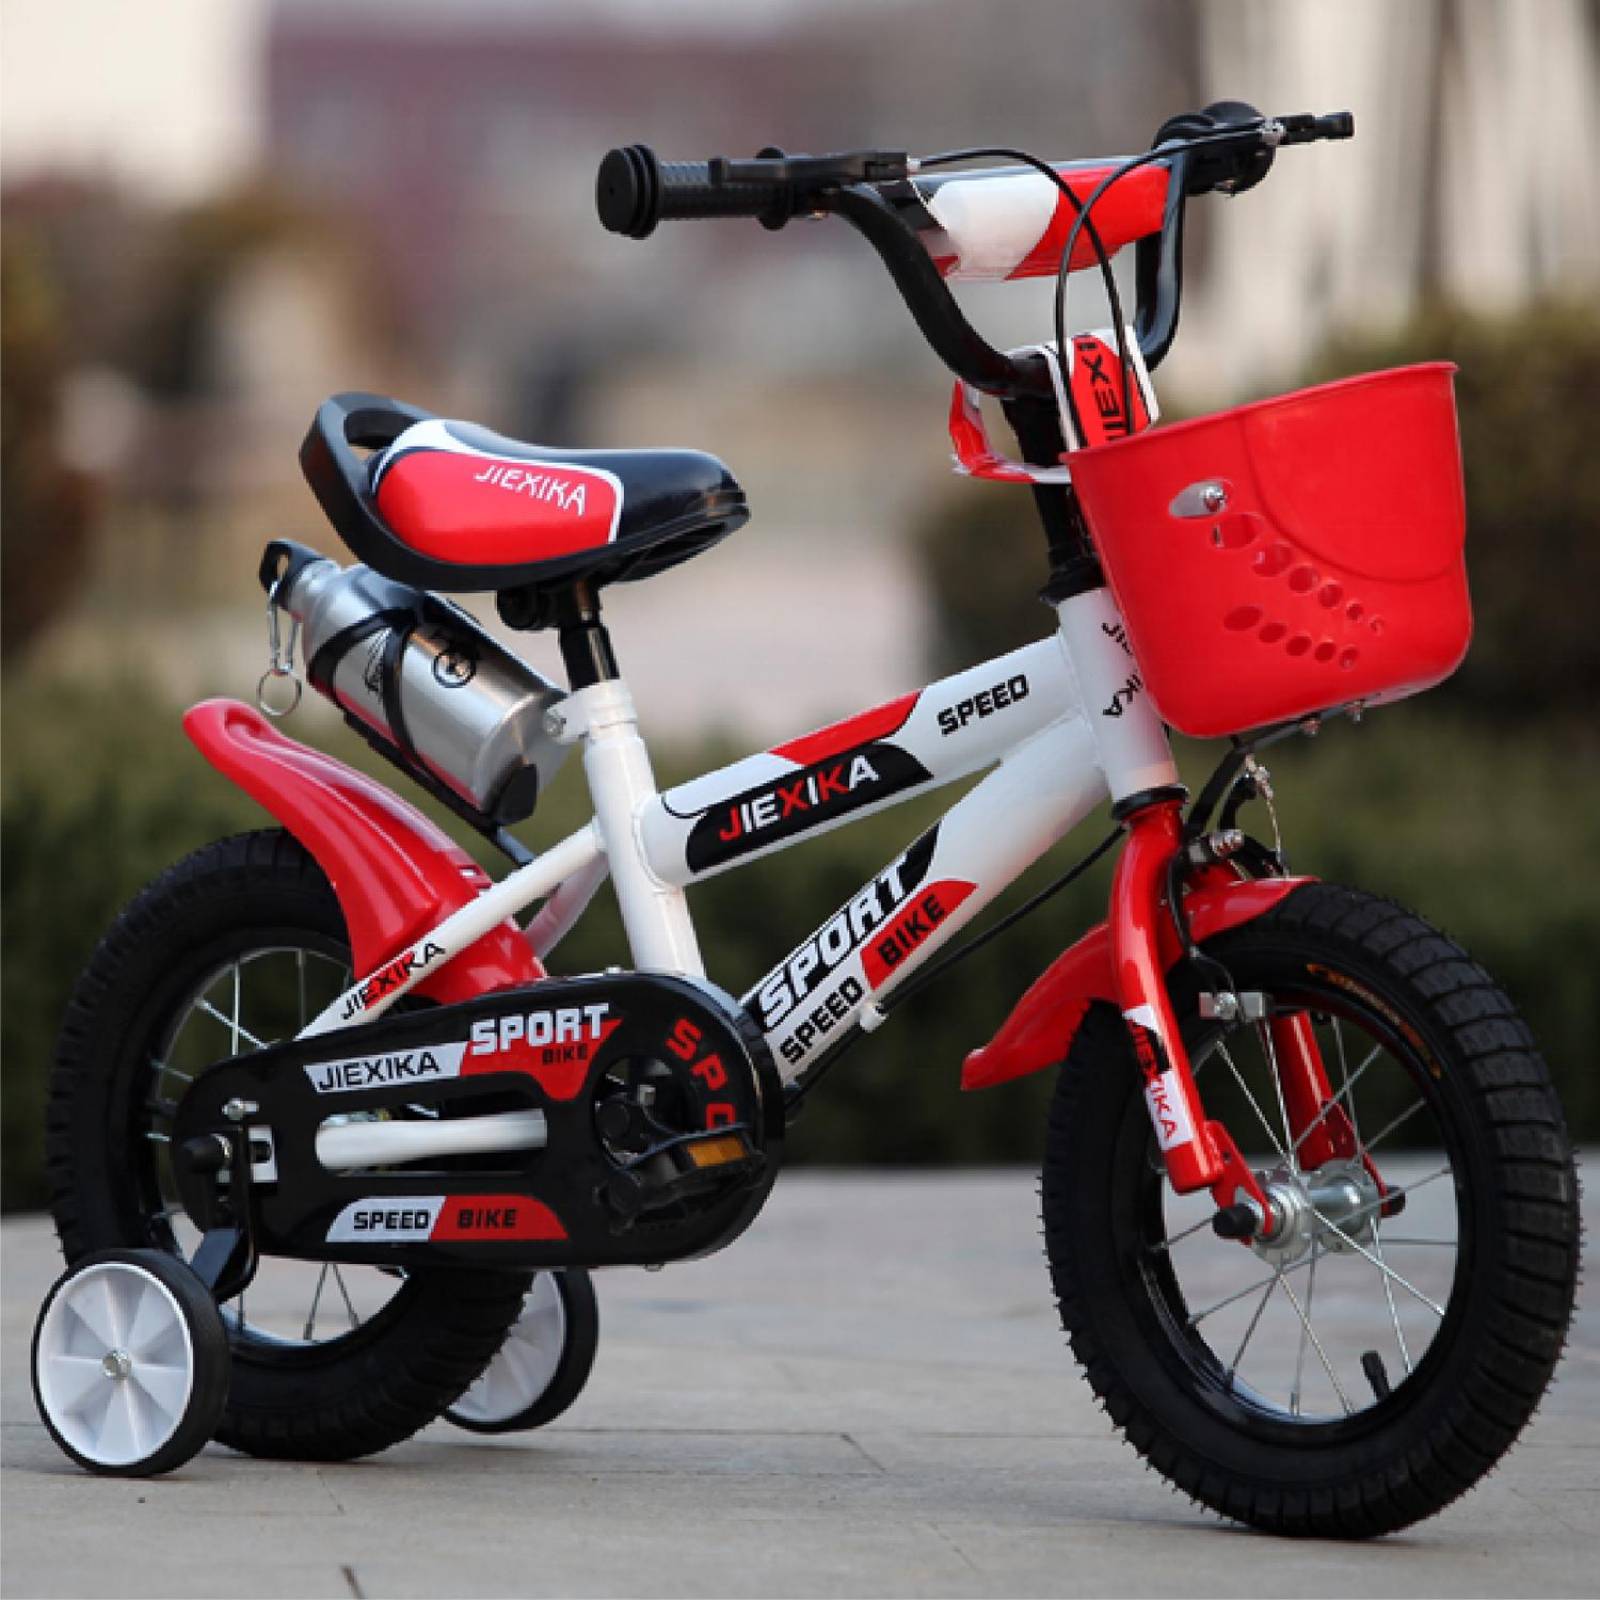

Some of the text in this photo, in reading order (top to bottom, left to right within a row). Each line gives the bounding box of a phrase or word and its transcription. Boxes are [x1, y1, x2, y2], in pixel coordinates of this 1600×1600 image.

[1076, 341, 1127, 441] IEXI
[473, 464, 587, 517] JIEXIKA
[936, 673, 1030, 736] SPEED
[719, 754, 880, 842] JIEXIKA
[758, 851, 908, 1031] SPORT
[877, 893, 946, 967] BIKE
[339, 942, 446, 1020] JIEXIKA
[470, 1002, 610, 1057] SPORT
[540, 1041, 588, 1066] BIKE
[780, 975, 865, 1064] SPEED
[318, 1050, 441, 1091] JIEXIKA
[352, 1208, 518, 1231] SPEED BIKE
